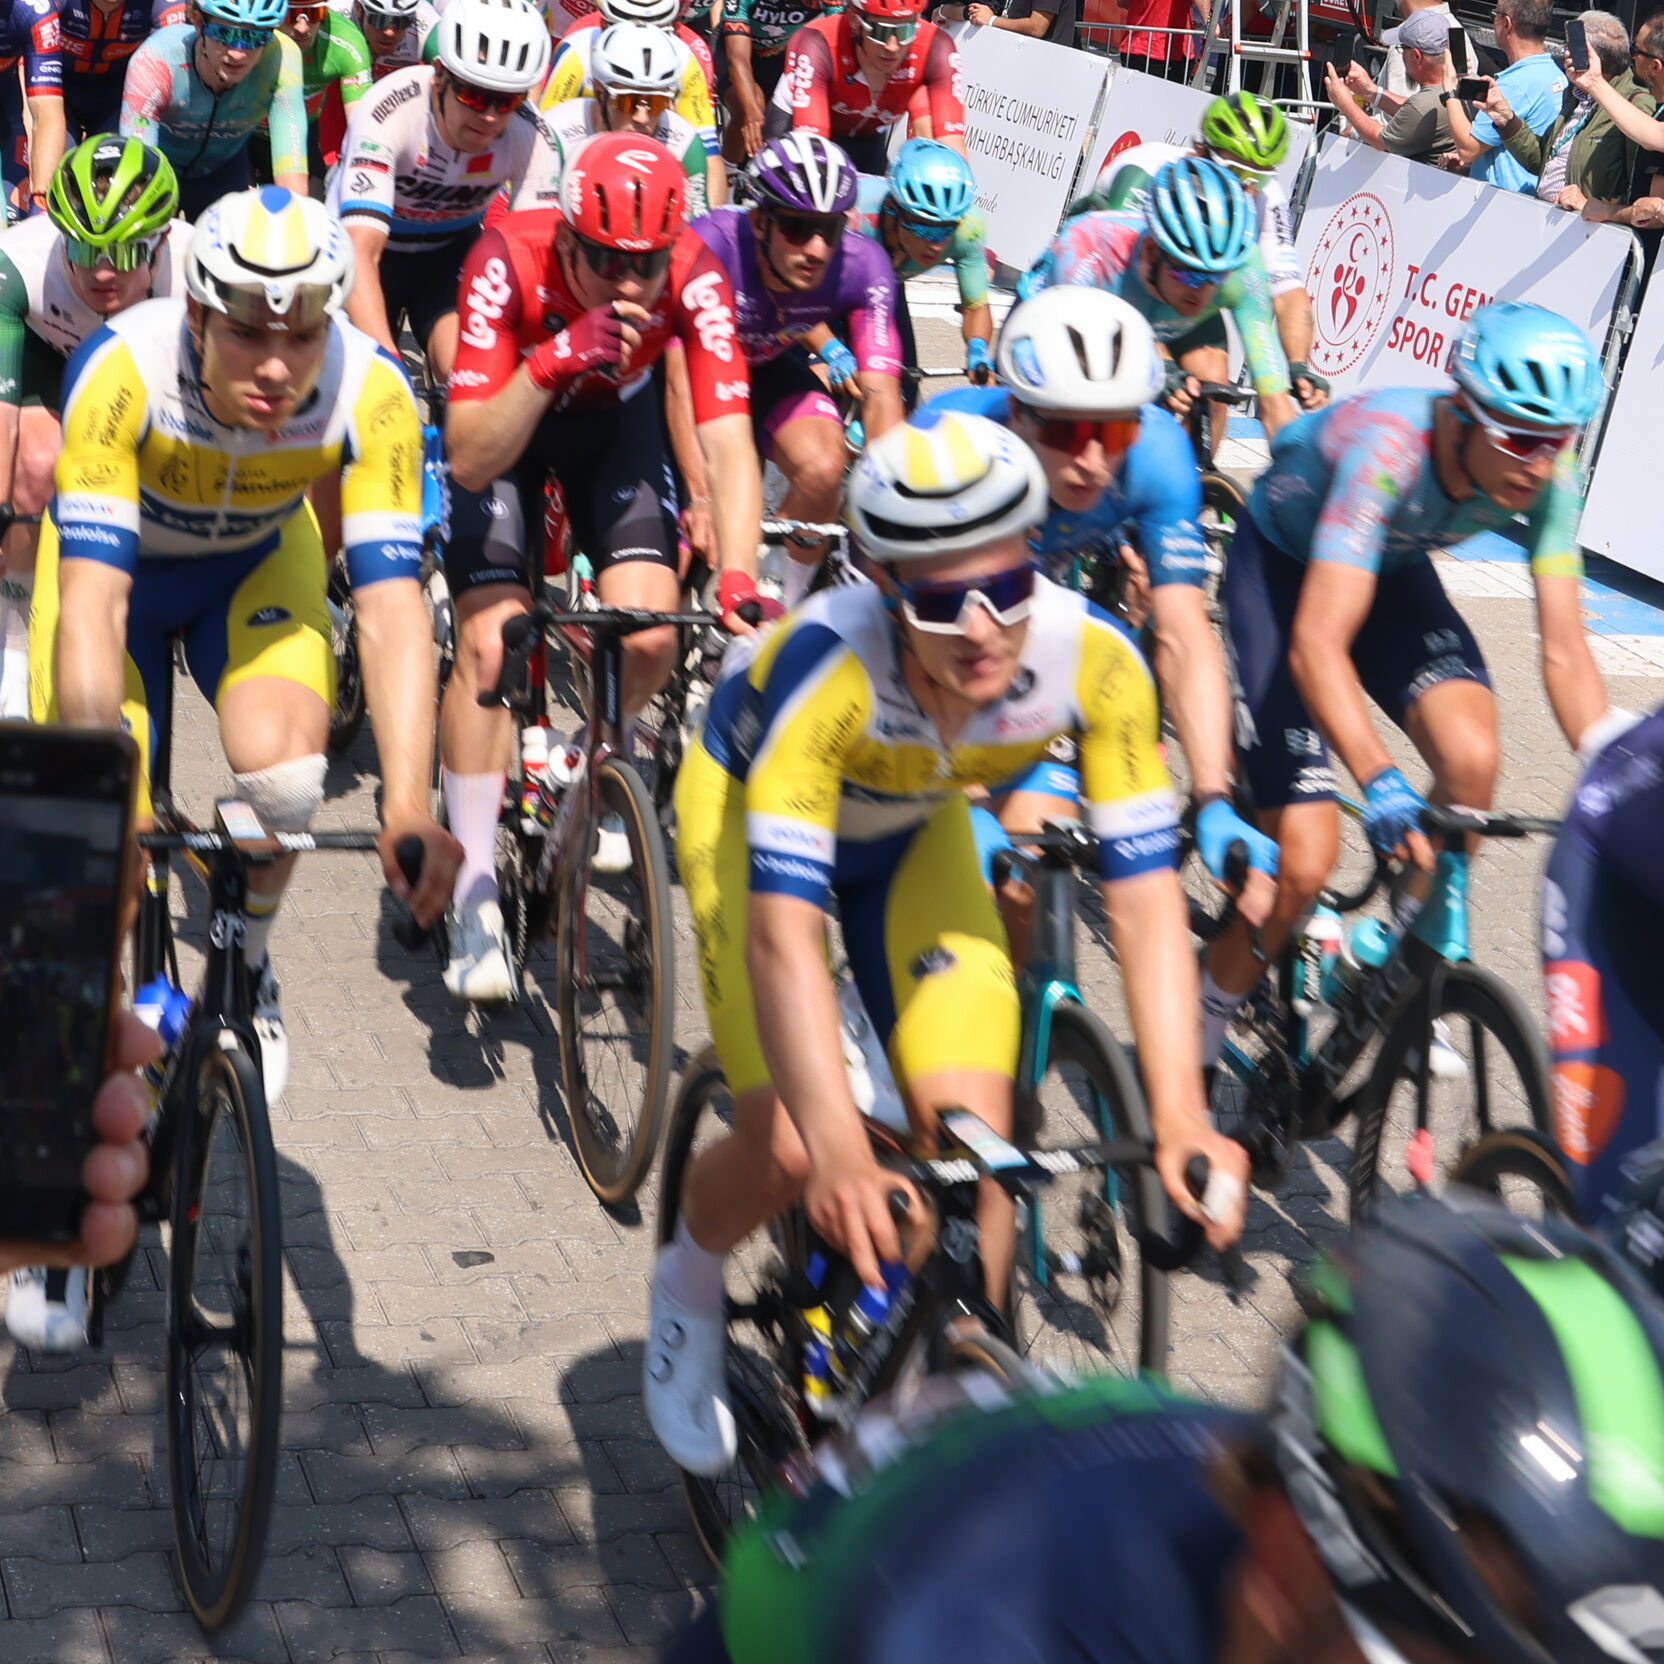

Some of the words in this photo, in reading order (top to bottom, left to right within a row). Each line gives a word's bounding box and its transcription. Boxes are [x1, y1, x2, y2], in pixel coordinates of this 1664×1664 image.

[753, 6, 806, 25] HYLO
[964, 82, 1007, 119] TÜRKİYE
[1005, 99, 1079, 142] CUMHURİYETİ
[964, 127, 1066, 181] MHURBAŞKANLIĞI
[1404, 263, 1438, 310] T.C.
[1387, 315, 1445, 369] SPOR
